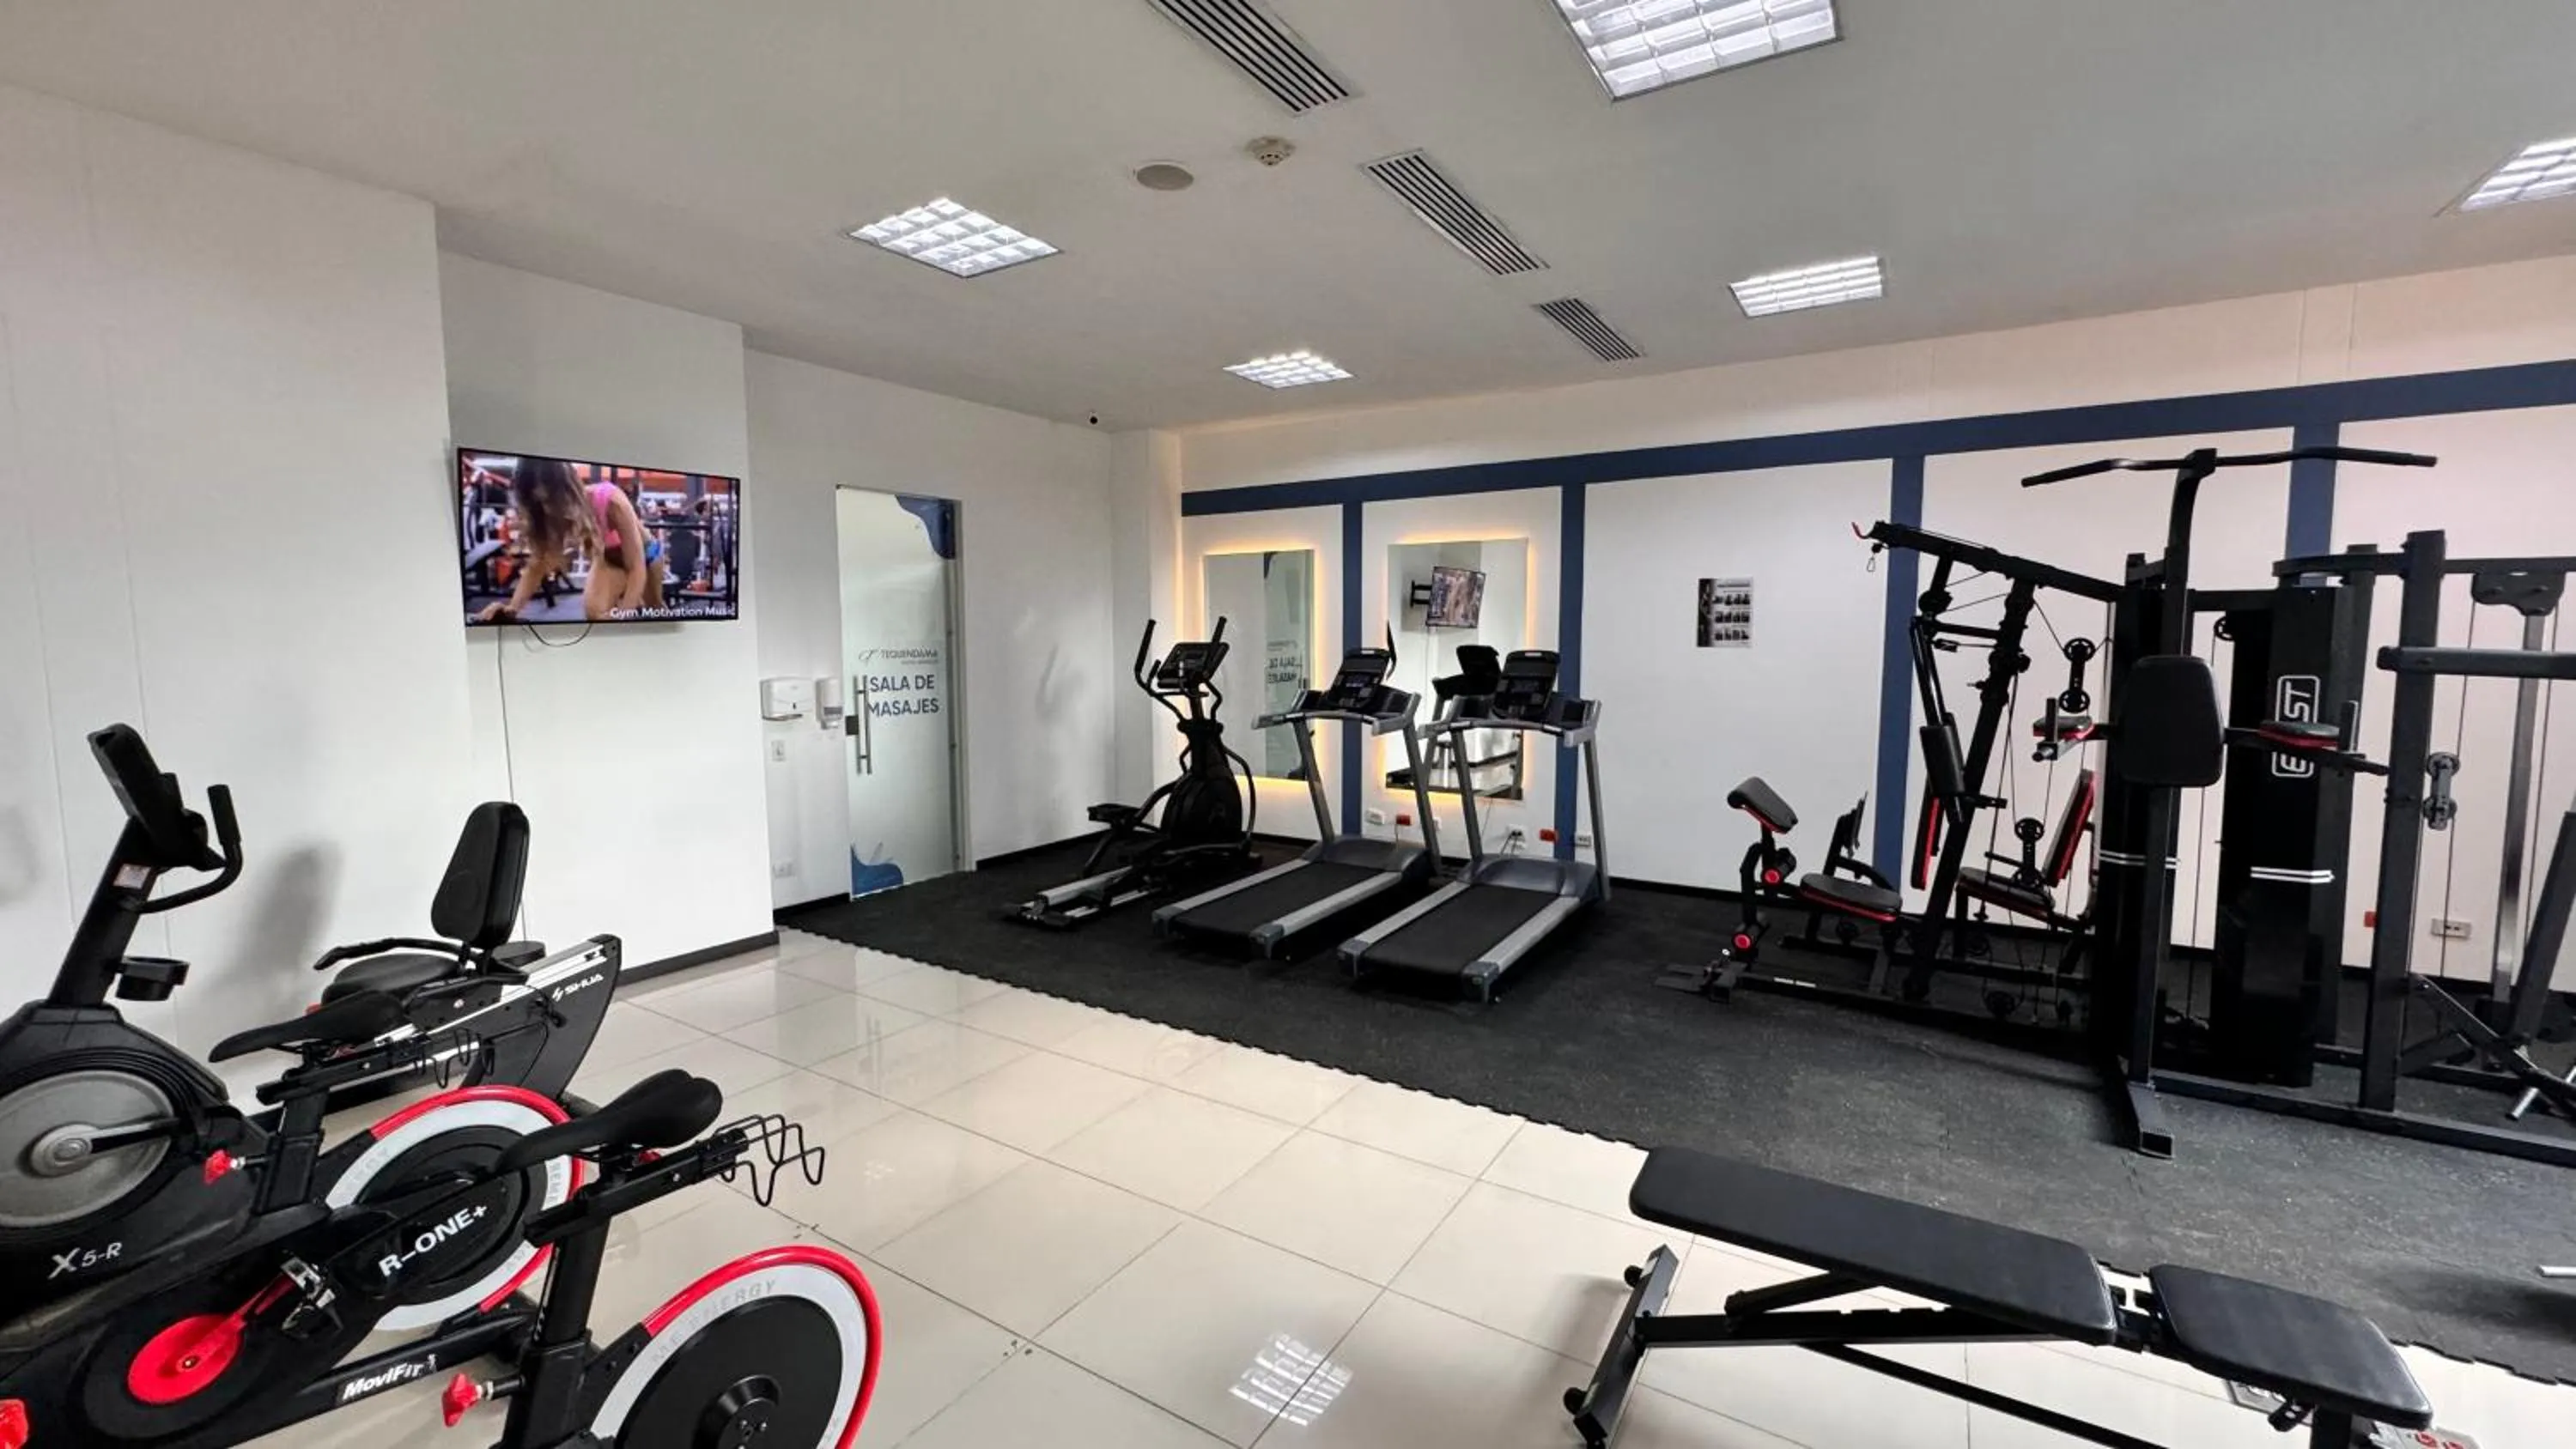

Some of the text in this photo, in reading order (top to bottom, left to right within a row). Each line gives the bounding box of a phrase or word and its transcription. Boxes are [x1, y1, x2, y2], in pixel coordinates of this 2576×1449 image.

[610, 607, 639, 620] Gym
[641, 607, 703, 617] Motivation
[869, 674, 935, 693] SALA DE
[866, 697, 939, 717] MASAJES
